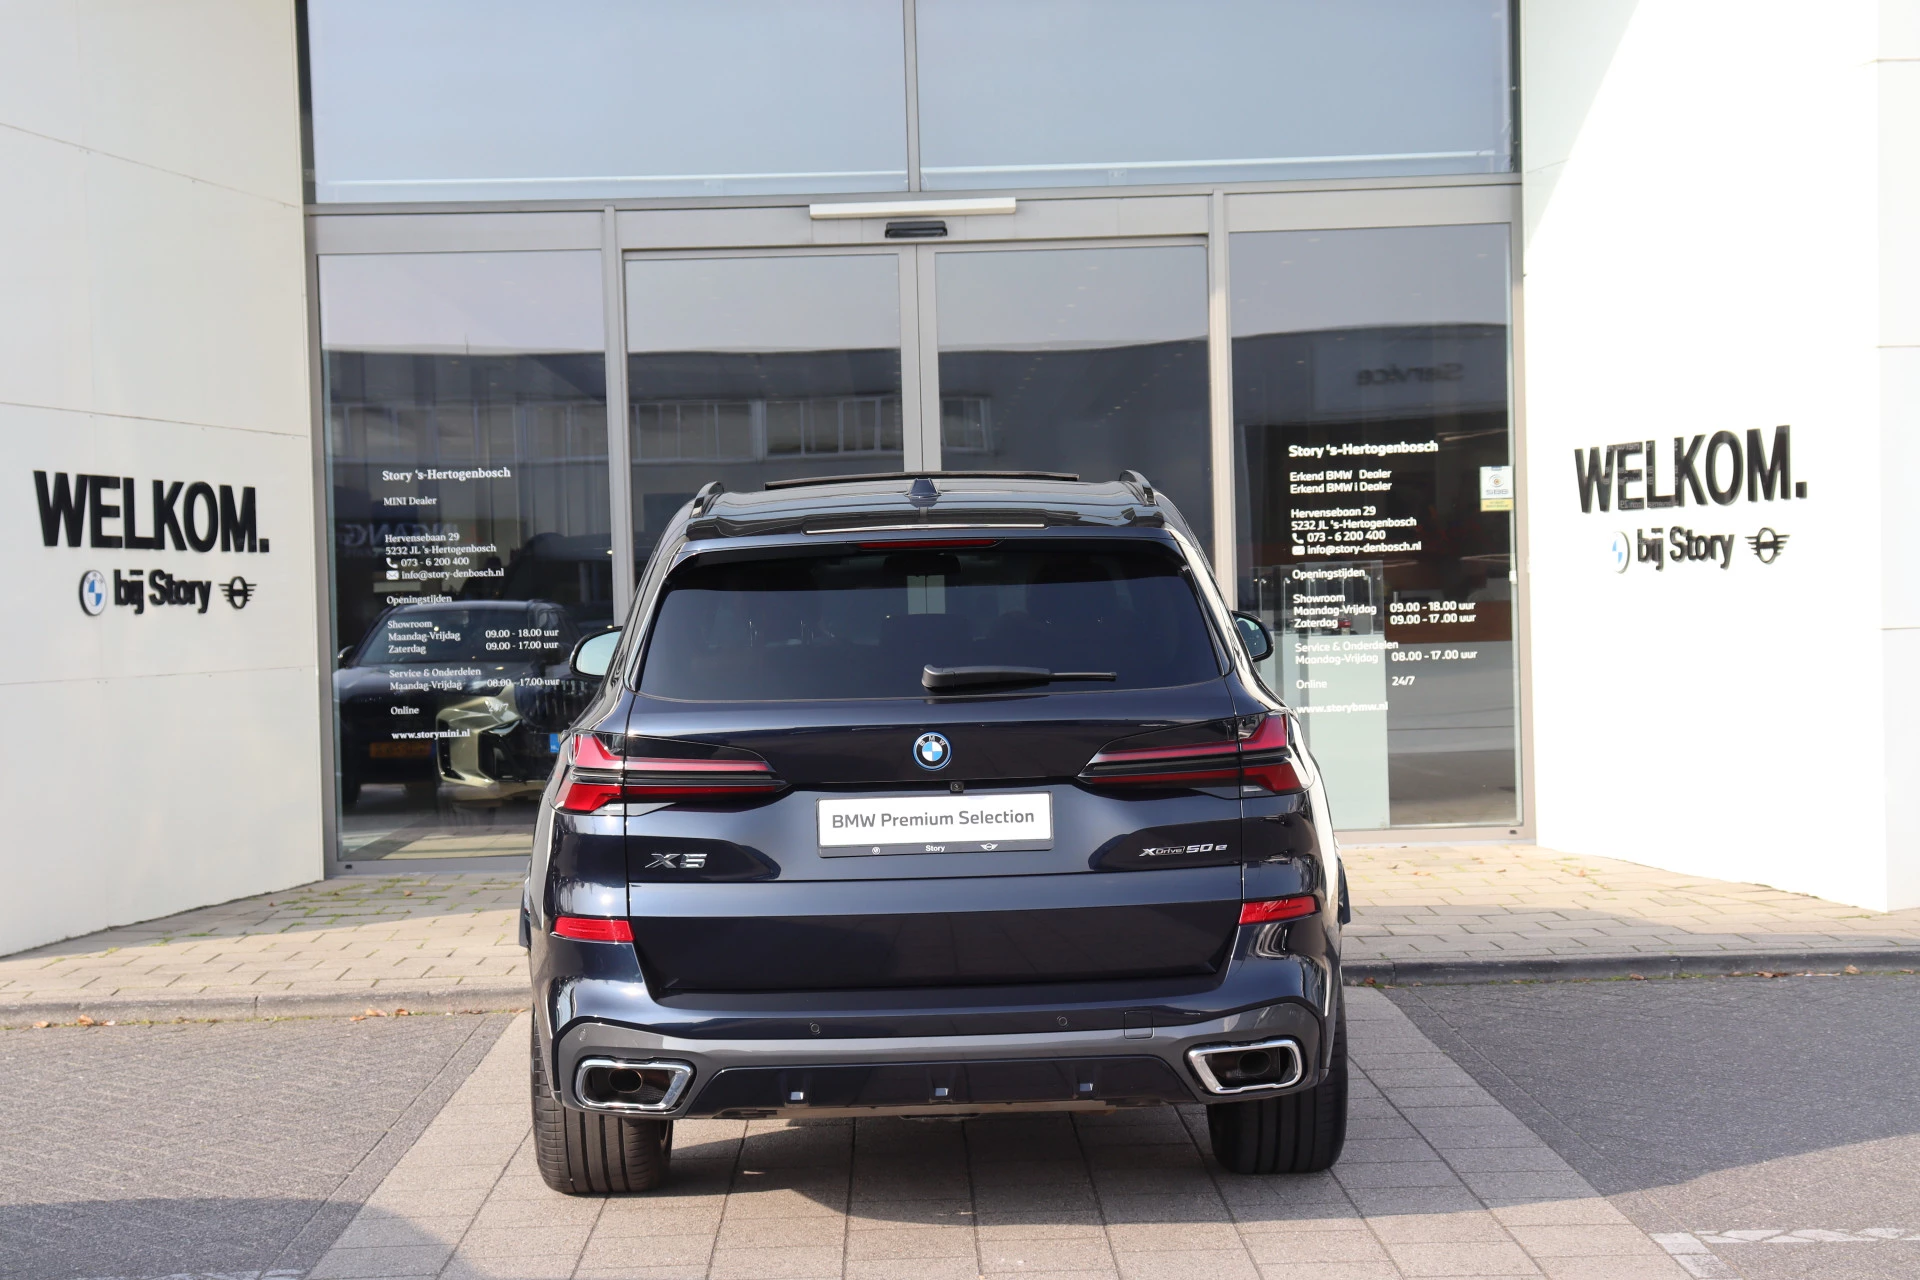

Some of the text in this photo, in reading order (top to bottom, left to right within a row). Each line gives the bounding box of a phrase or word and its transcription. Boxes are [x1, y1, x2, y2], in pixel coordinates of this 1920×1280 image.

[1288, 445, 1324, 459] Story
[1290, 469, 1392, 482] Erkend BMW Dealer
[1574, 424, 1808, 514] WELKOM.
[382, 470, 412, 483] Story
[1290, 481, 1392, 494] Erkend BMW i Dealer
[383, 496, 437, 506] MINI Dealer
[33, 469, 270, 553] WELKOM.
[1291, 506, 1376, 518] Hervensebaan 29
[1291, 520, 1316, 531] 5232
[1317, 519, 1329, 530] JL
[385, 532, 460, 543] Hervensebaan 29
[1307, 532, 1326, 542] 073
[1334, 531, 1342, 541] 6
[1343, 531, 1364, 541] 200
[1365, 530, 1386, 540] 400
[385, 546, 408, 555] 5232
[409, 545, 421, 555] JL
[1307, 541, 1422, 556] info@story-denbosch.nl
[1637, 525, 1735, 572] bij Story
[400, 557, 418, 567] 073
[425, 557, 432, 566] 6
[433, 557, 450, 566] 200
[452, 557, 470, 565] 400
[401, 568, 505, 580] info@story-denbosch.nl
[1292, 568, 1366, 581] Openingstijden
[113, 569, 212, 614] bij Story
[386, 595, 452, 606] Openingstijden
[1293, 593, 1346, 604] Showroom
[1293, 604, 1377, 617] Maandag-Vrijdag
[1390, 602, 1420, 613] 09.00
[1428, 601, 1456, 611] 18.00
[1459, 602, 1476, 611] uur
[387, 620, 433, 629] Showroom
[1294, 617, 1338, 629] Zaterdag
[1390, 614, 1420, 625] 09.00
[1459, 613, 1476, 623] uur
[388, 632, 461, 642] Maandag-Vrijdag
[485, 629, 510, 639] 09.00
[518, 629, 542, 638] 18.00
[388, 645, 427, 654] Zaterdag
[486, 642, 510, 651] 09.00
[518, 641, 542, 650] 17.00
[1295, 640, 1399, 653] Service & Onderdelen
[1295, 652, 1378, 665] Maandag-Vrijdag
[1391, 651, 1422, 662] 08.00
[1461, 650, 1478, 660] uur
[389, 667, 481, 678] Service & Onderdelen
[390, 680, 463, 691] Maandag-Vrijdag
[519, 678, 542, 687] 17.00
[544, 678, 560, 686] uur
[1296, 675, 1415, 689] Online 24/7
[390, 706, 420, 715] Online
[1296, 701, 1388, 714] www.storybmw.nl
[391, 728, 470, 740] www.storymini.nl
[832, 809, 1035, 829] BMW Premium Selection
[925, 844, 946, 853] Story
[644, 853, 708, 869] X5
